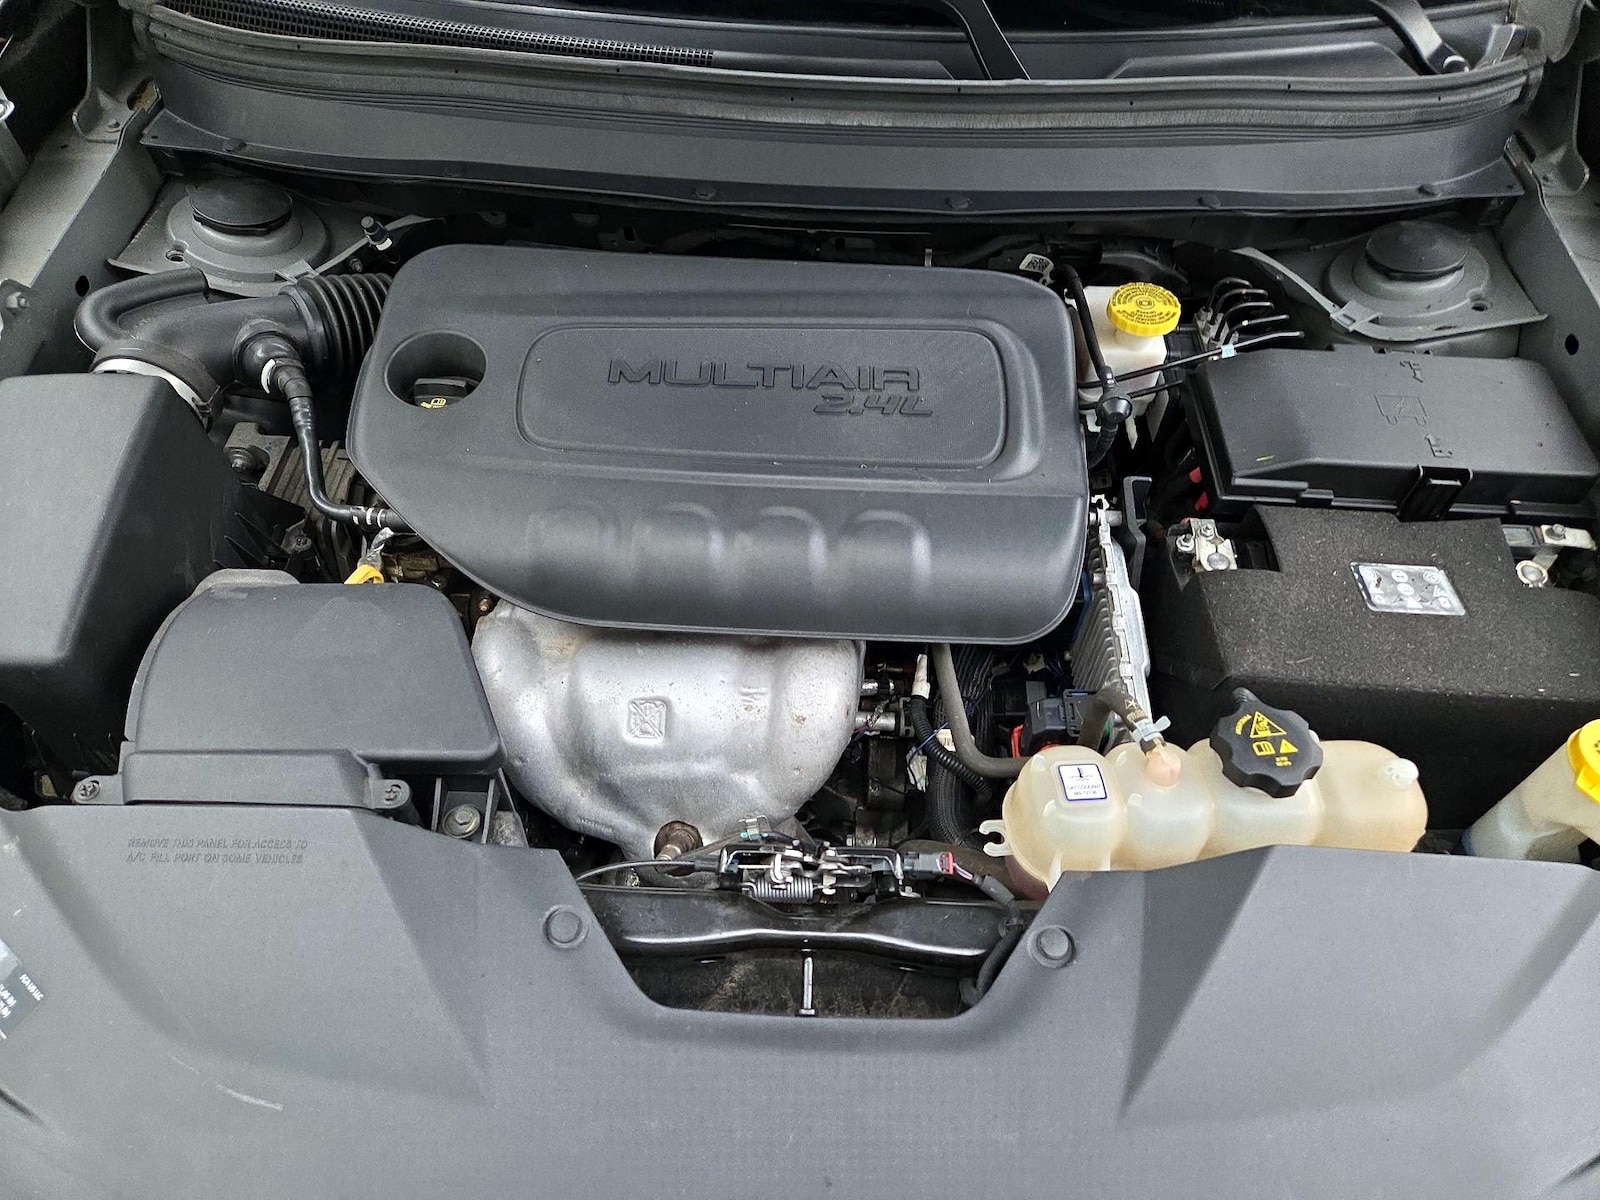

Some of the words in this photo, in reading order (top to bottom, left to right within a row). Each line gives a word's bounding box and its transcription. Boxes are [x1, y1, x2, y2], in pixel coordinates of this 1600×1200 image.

[607, 359, 919, 391] MULTIAIR
[813, 395, 934, 417] 2.4L
[128, 838, 169, 848] REMOVE
[196, 838, 228, 849] PANEL
[230, 838, 251, 849] FOR
[126, 852, 146, 862] A/C
[149, 852, 170, 863] FILL
[173, 852, 200, 863] PORT
[203, 852, 219, 863] ON
[254, 852, 303, 864] VEHICLES
